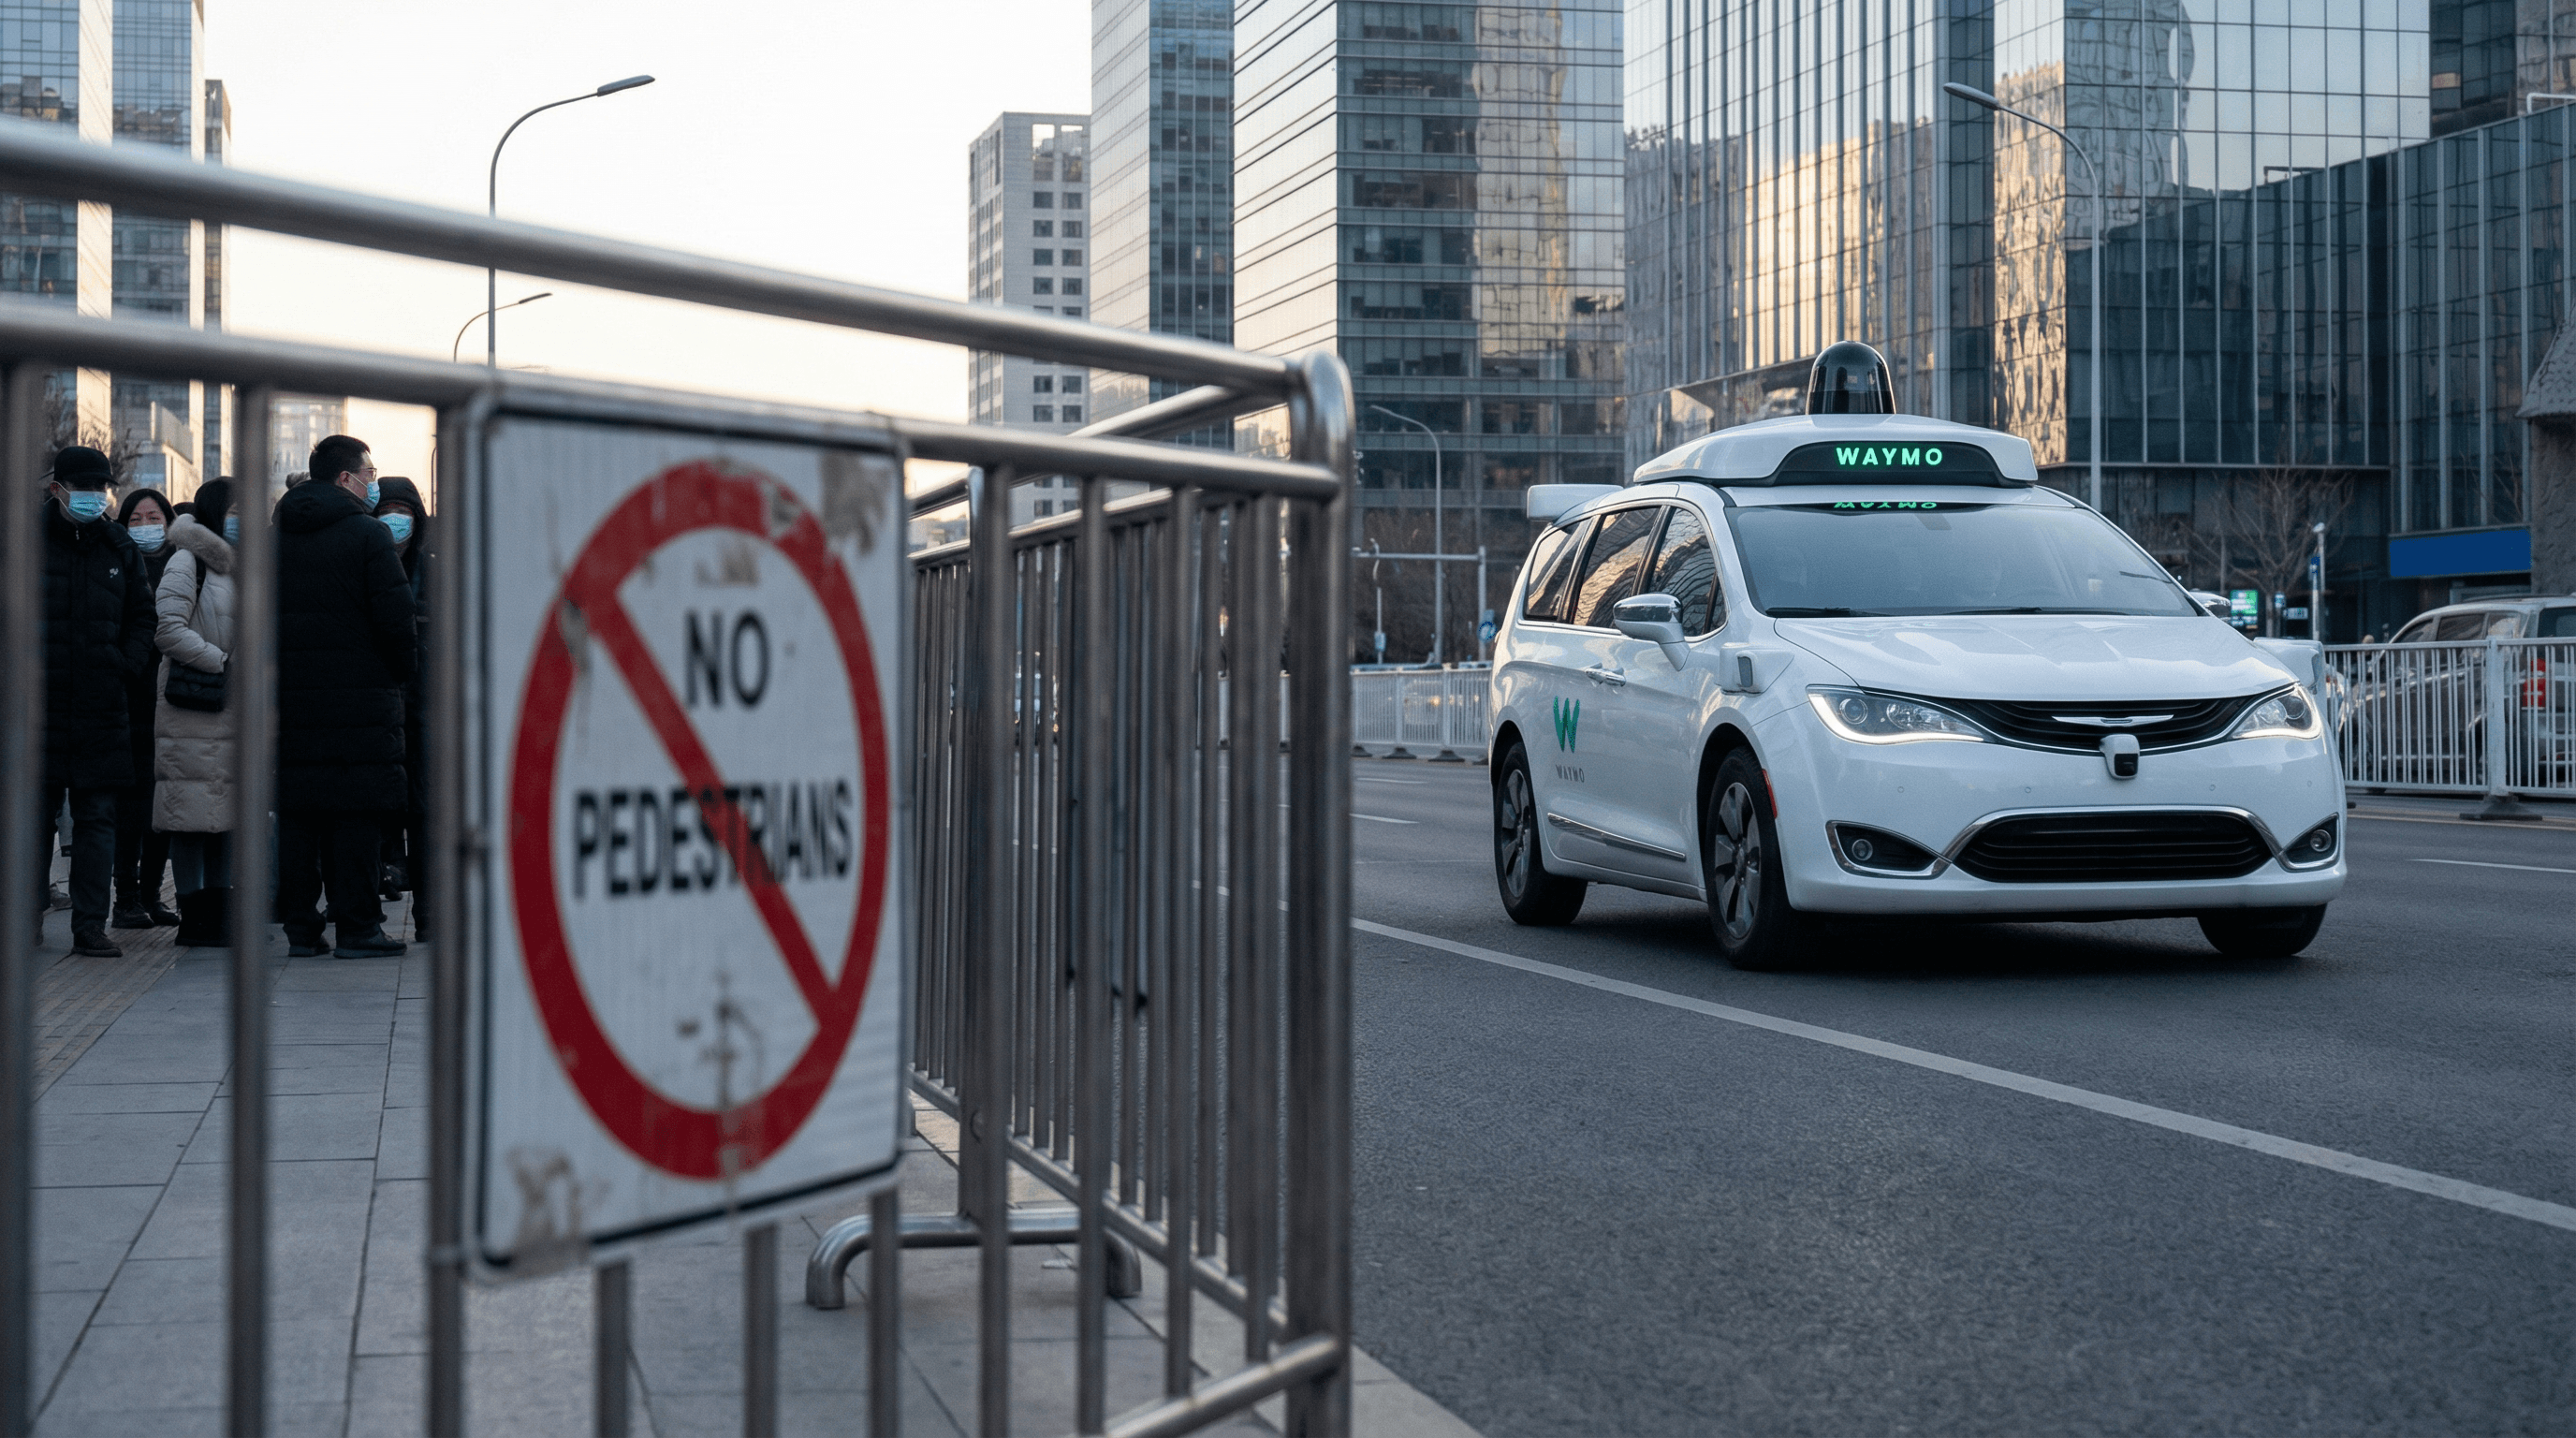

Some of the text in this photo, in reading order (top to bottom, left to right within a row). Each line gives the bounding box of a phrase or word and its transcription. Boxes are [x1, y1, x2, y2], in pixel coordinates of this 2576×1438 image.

[1836, 447, 1942, 465] WAYMO
[686, 608, 770, 711] NO
[1553, 696, 1580, 754] W
[573, 778, 853, 901] PEDESTRIANS
